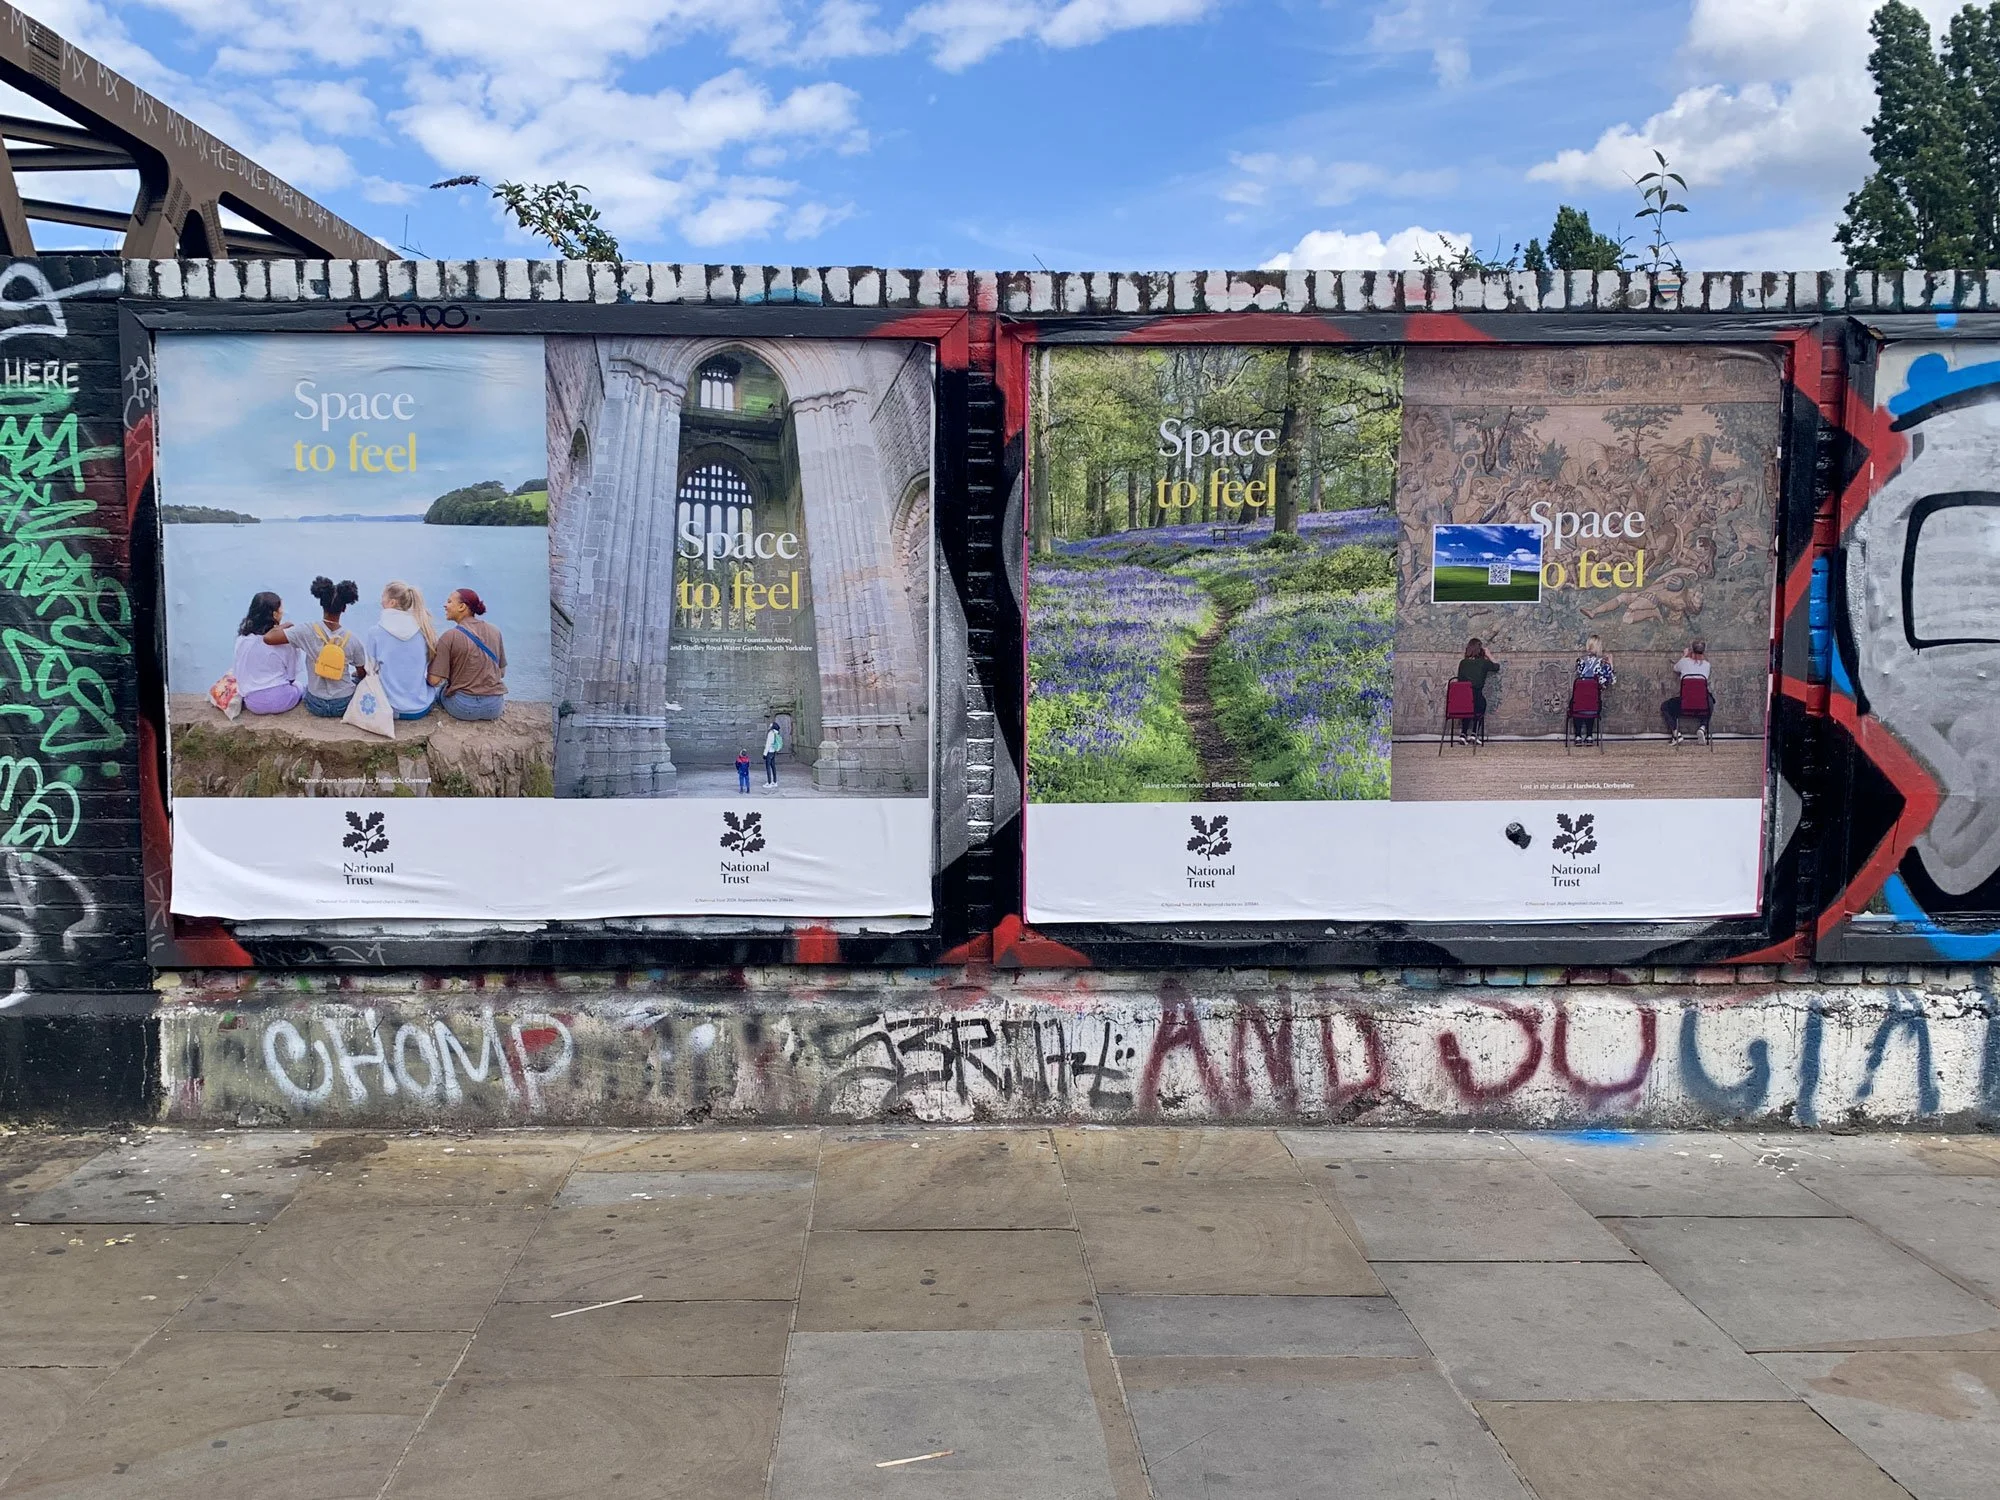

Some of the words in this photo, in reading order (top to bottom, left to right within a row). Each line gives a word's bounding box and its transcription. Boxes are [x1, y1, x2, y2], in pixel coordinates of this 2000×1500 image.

[4, 357, 80, 393] HERE
[294, 381, 415, 431] Space
[1159, 418, 1277, 468] Space
[293, 440, 336, 472] to
[349, 432, 417, 472] feel
[1156, 476, 1198, 508] to
[1210, 467, 1277, 508] feel
[1530, 501, 1646, 550] Space
[680, 520, 798, 570] Space
[1542, 561, 1566, 588] o
[1578, 549, 1645, 588] feel
[677, 577, 720, 609] to
[732, 570, 799, 609] feel
[773, 636, 792, 645] Abbey
[682, 644, 705, 652] Studley
[706, 644, 722, 652] Royal
[785, 644, 813, 652] Yorkshire
[1603, 782, 1635, 790] Derbyshire
[343, 862, 394, 874] National
[720, 861, 769, 872] National
[1186, 864, 1235, 876] National
[1551, 863, 1600, 875] National
[343, 874, 375, 885] Trust
[720, 873, 750, 884] Trust
[1186, 877, 1215, 889] Trust
[1551, 876, 1580, 888] Trust
[262, 1004, 574, 1107] CHOMP
